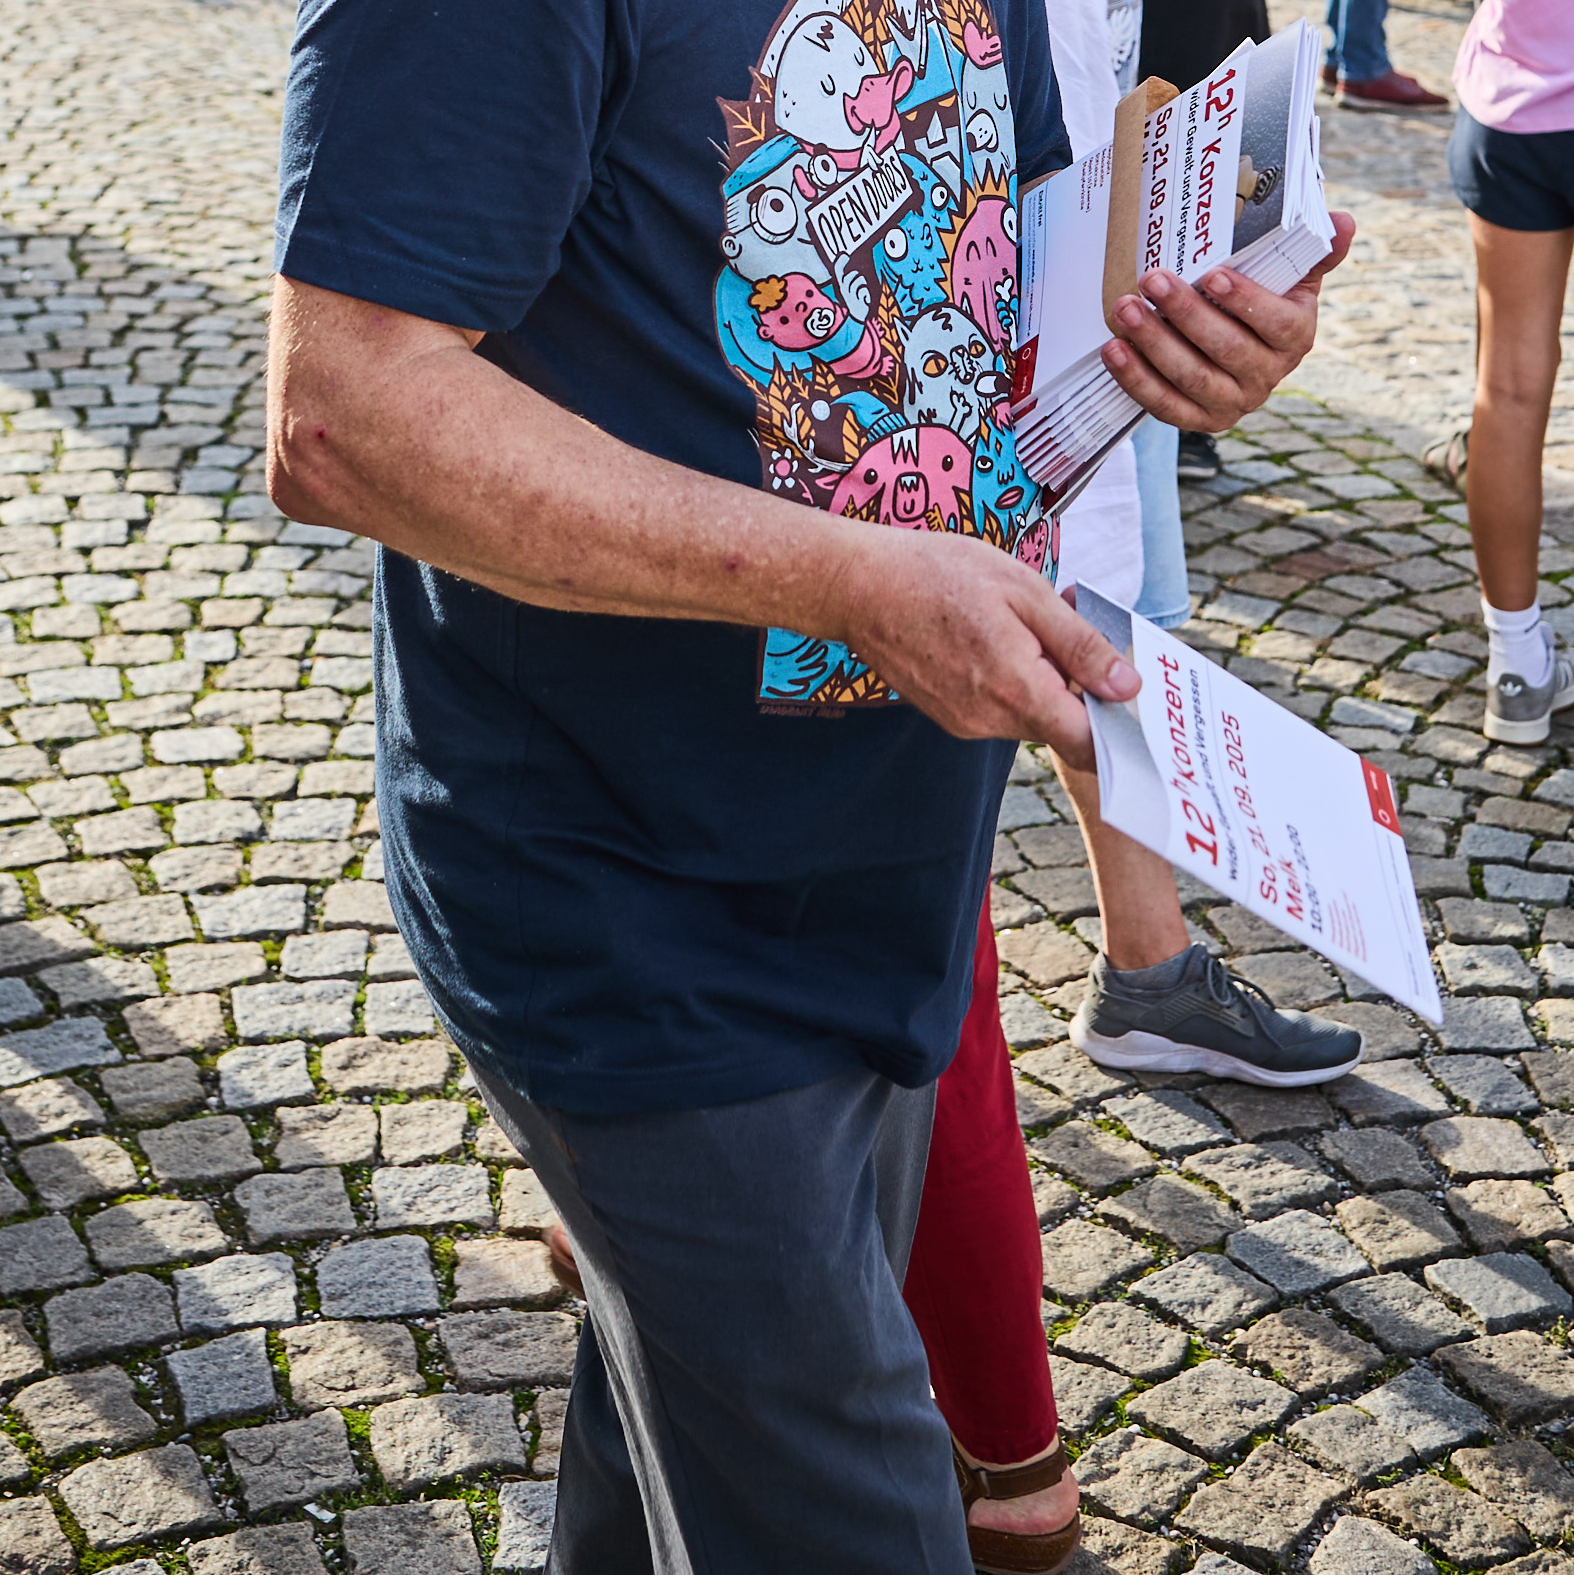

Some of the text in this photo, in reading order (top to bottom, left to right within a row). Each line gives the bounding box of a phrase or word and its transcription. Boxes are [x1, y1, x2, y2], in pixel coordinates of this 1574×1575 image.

[818, 184, 873, 257] OPEN
[1176, 88, 1200, 275] wider Gewalt und Vergessen
[1192, 137, 1222, 264] Konzert
[1157, 653, 1199, 787] Konzert
[1190, 669, 1209, 749] Vergessen
[1196, 751, 1213, 780] und
[1279, 855, 1304, 922] Melk
